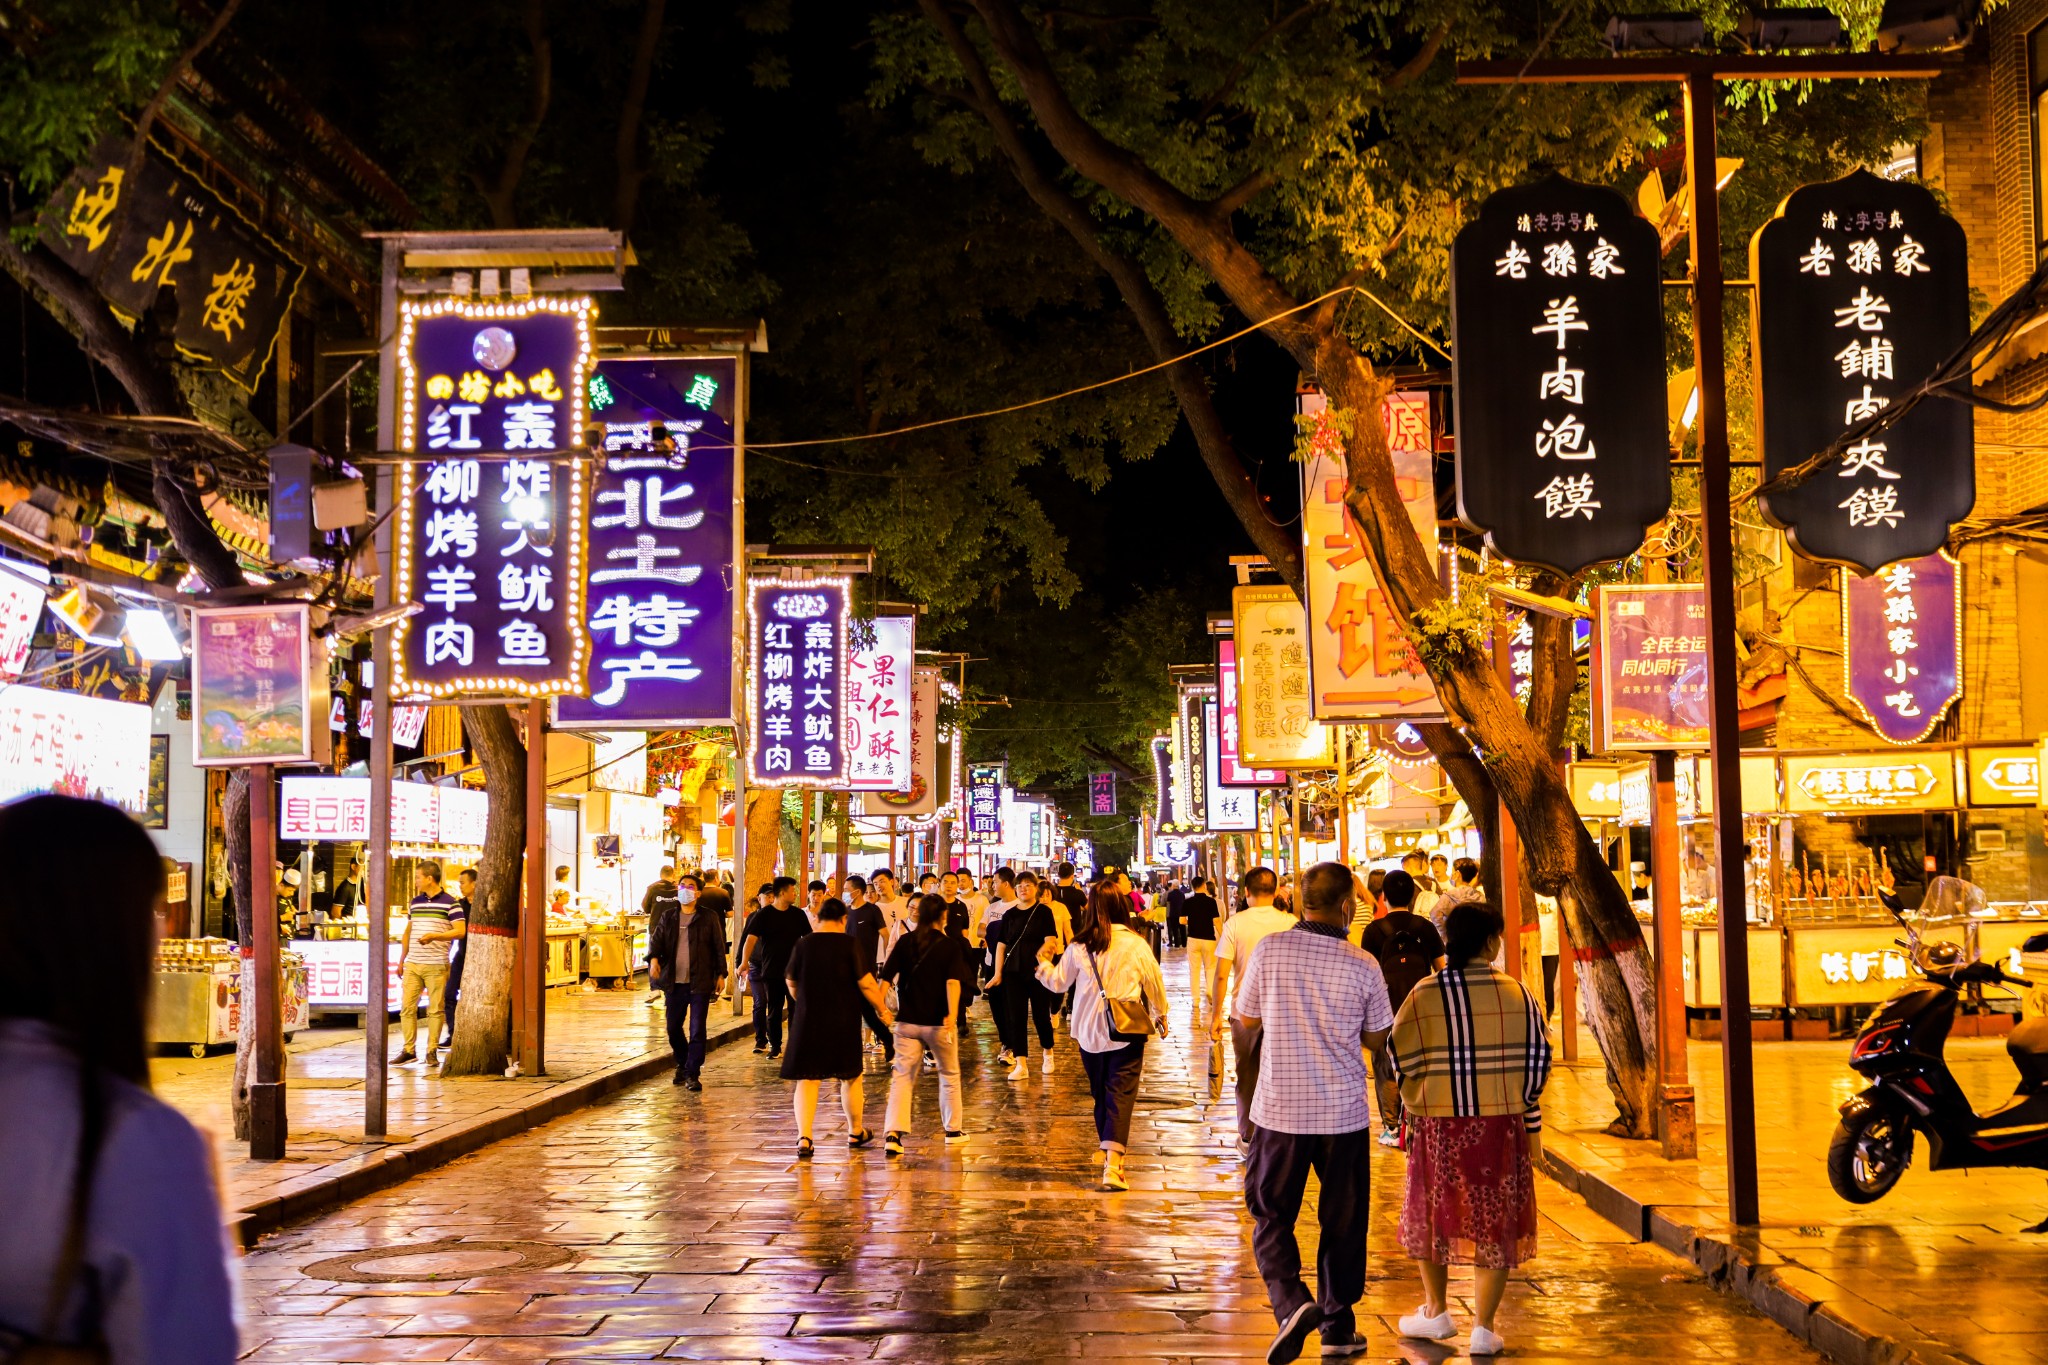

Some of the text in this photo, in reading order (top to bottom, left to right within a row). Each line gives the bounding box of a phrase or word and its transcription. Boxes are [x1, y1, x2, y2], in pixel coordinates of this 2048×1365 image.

[425, 404, 483, 666] 红柳烤羊肉
[497, 401, 556, 666] 轰炸大鱿鱼
[590, 419, 704, 706] 西北土特产
[764, 622, 793, 772] 红柳烤羊肉
[803, 621, 833, 772] 轰炸大鱿鱼
[867, 654, 901, 760] 果仁酥
[1253, 642, 1277, 738] 牛羊肉泡馍
[1621, 658, 1688, 677] 同心同行
[1641, 636, 1706, 654] 全民全运
[287, 797, 366, 834] 臭豆腐
